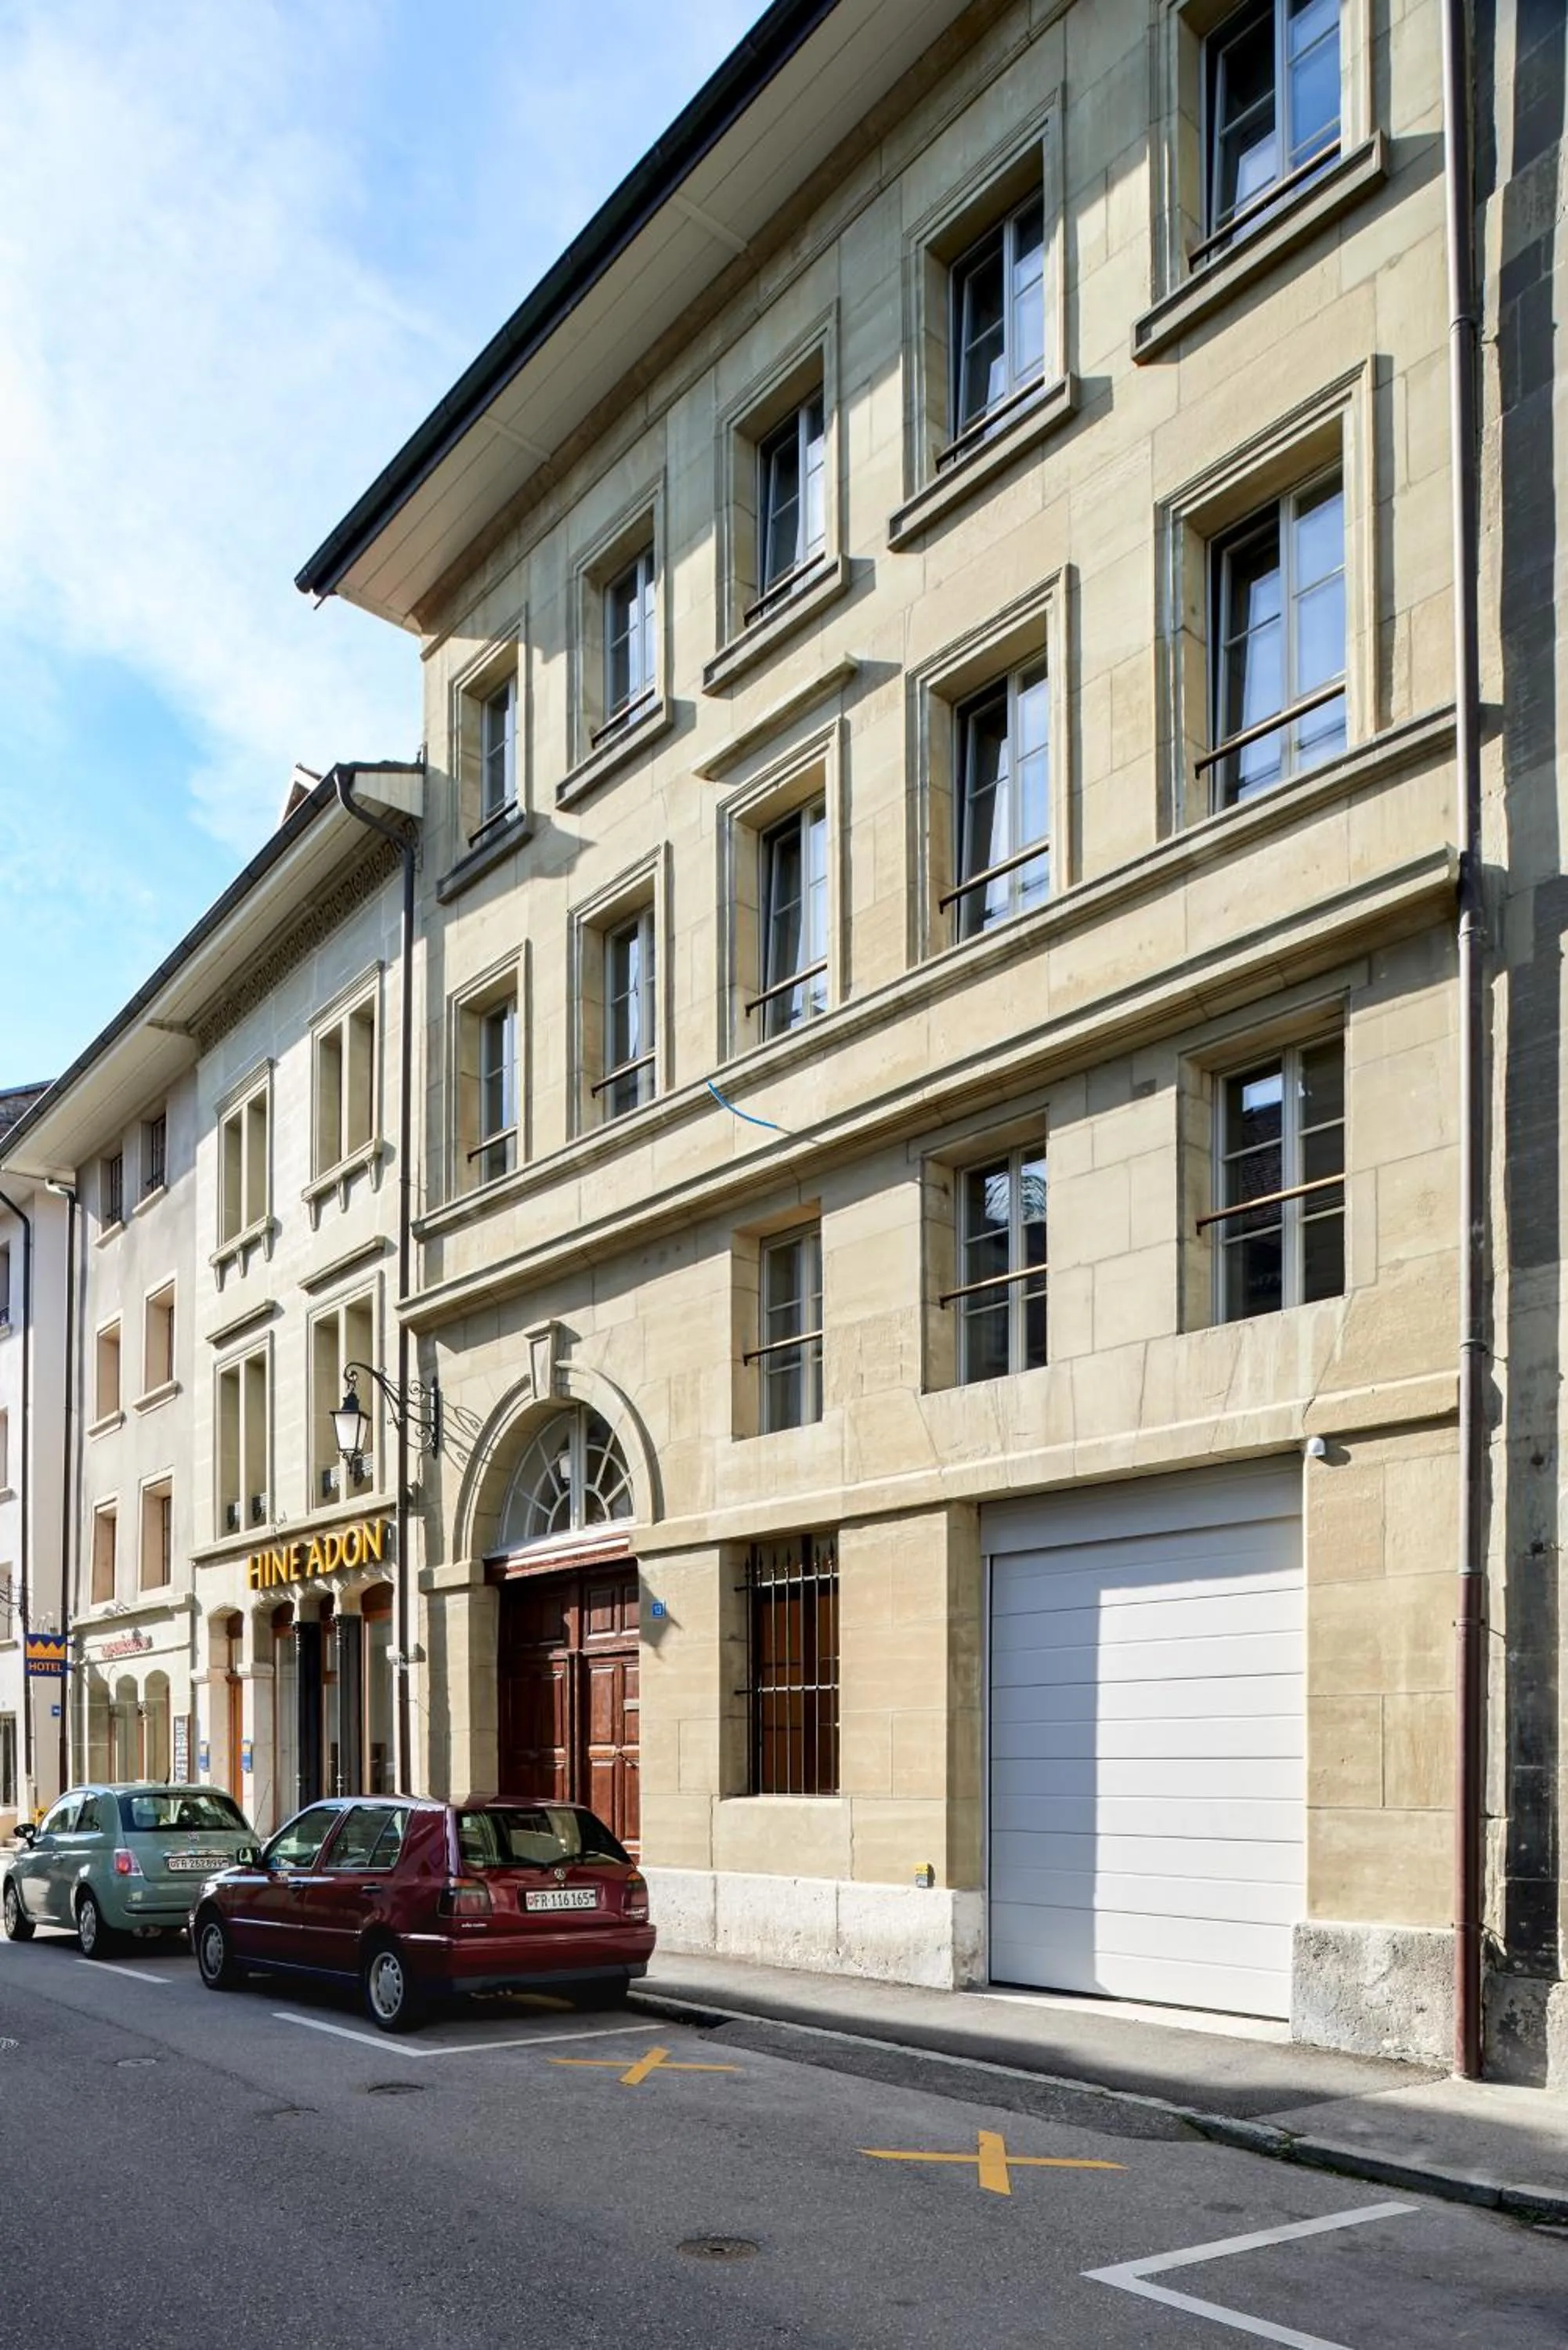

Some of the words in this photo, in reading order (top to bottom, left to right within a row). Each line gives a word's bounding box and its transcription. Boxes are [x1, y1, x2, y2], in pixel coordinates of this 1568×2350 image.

[247, 1542, 301, 1591] HINE
[305, 1518, 383, 1578] ADON
[28, 1661, 63, 1672] HOTEL
